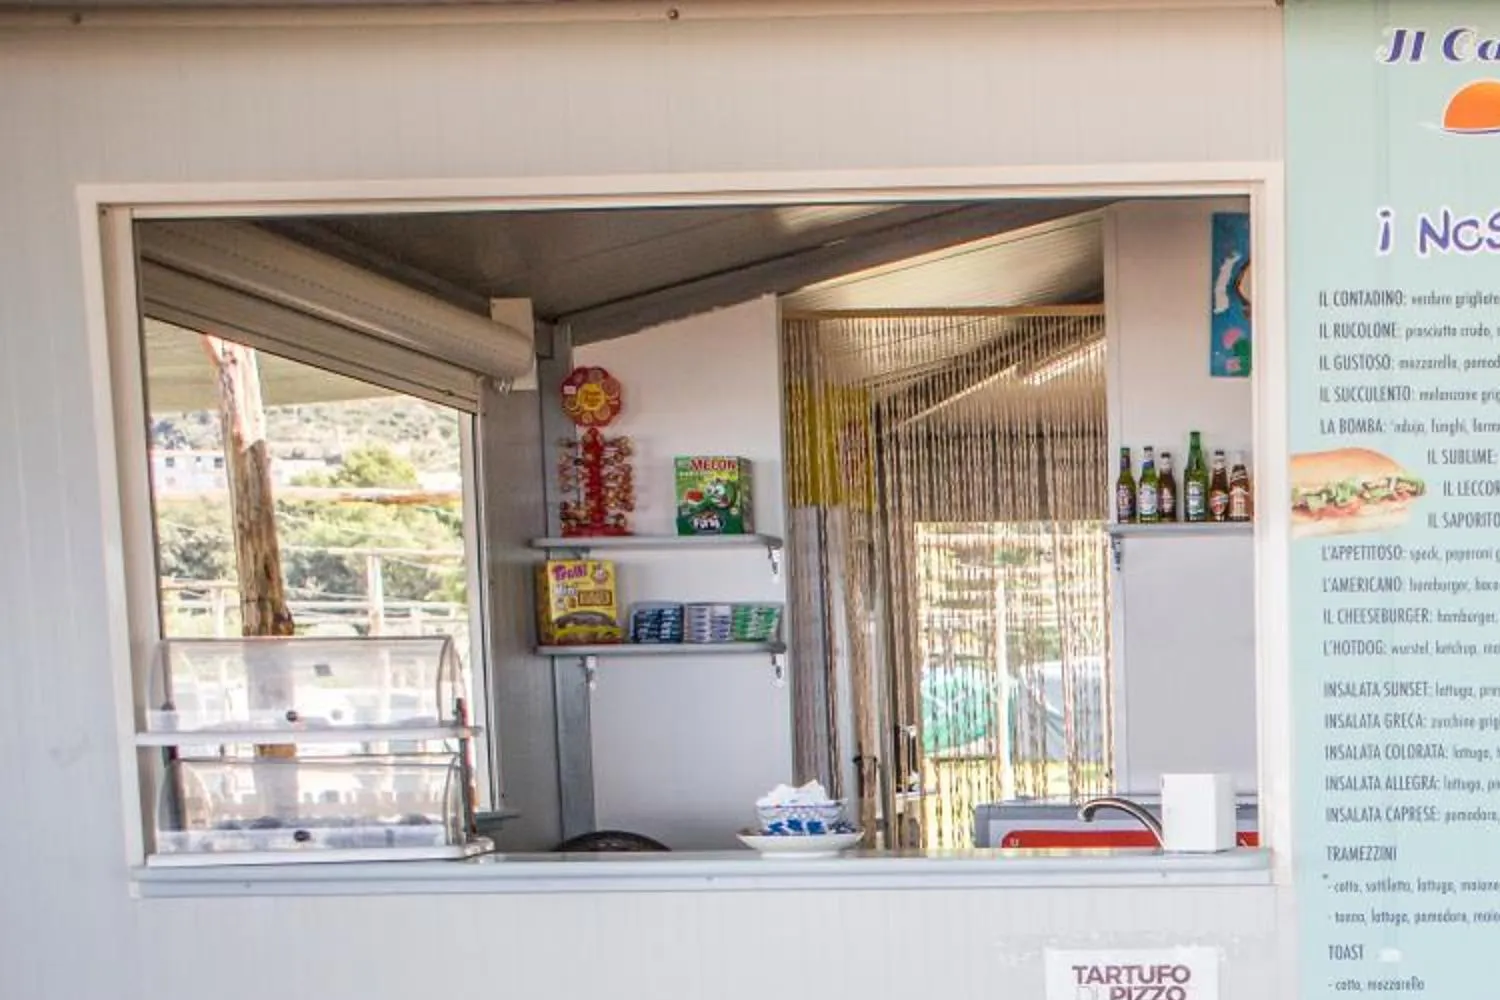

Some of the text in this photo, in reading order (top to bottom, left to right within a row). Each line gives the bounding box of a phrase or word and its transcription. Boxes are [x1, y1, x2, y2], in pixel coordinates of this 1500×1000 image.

[1319, 290, 1329, 308] IL
[1319, 321, 1330, 340] IL
[1319, 354, 1330, 372] IL
[1320, 385, 1331, 403] IL
[1320, 418, 1336, 435] LA
[1427, 447, 1438, 465] IL
[1443, 480, 1454, 497] IL
[1428, 512, 1440, 529] IL
[1323, 608, 1334, 625] IL
[1324, 681, 1381, 698] INSALATA
[1325, 713, 1381, 729] INSALATA
[1325, 743, 1381, 761] INSALATA
[1325, 775, 1382, 792] INSALATA
[1326, 805, 1382, 823] INSALATA
[1327, 845, 1397, 862] TRAMEZZINI
[1328, 944, 1363, 961] TOAST
[1072, 965, 1191, 984] TARTUFO
